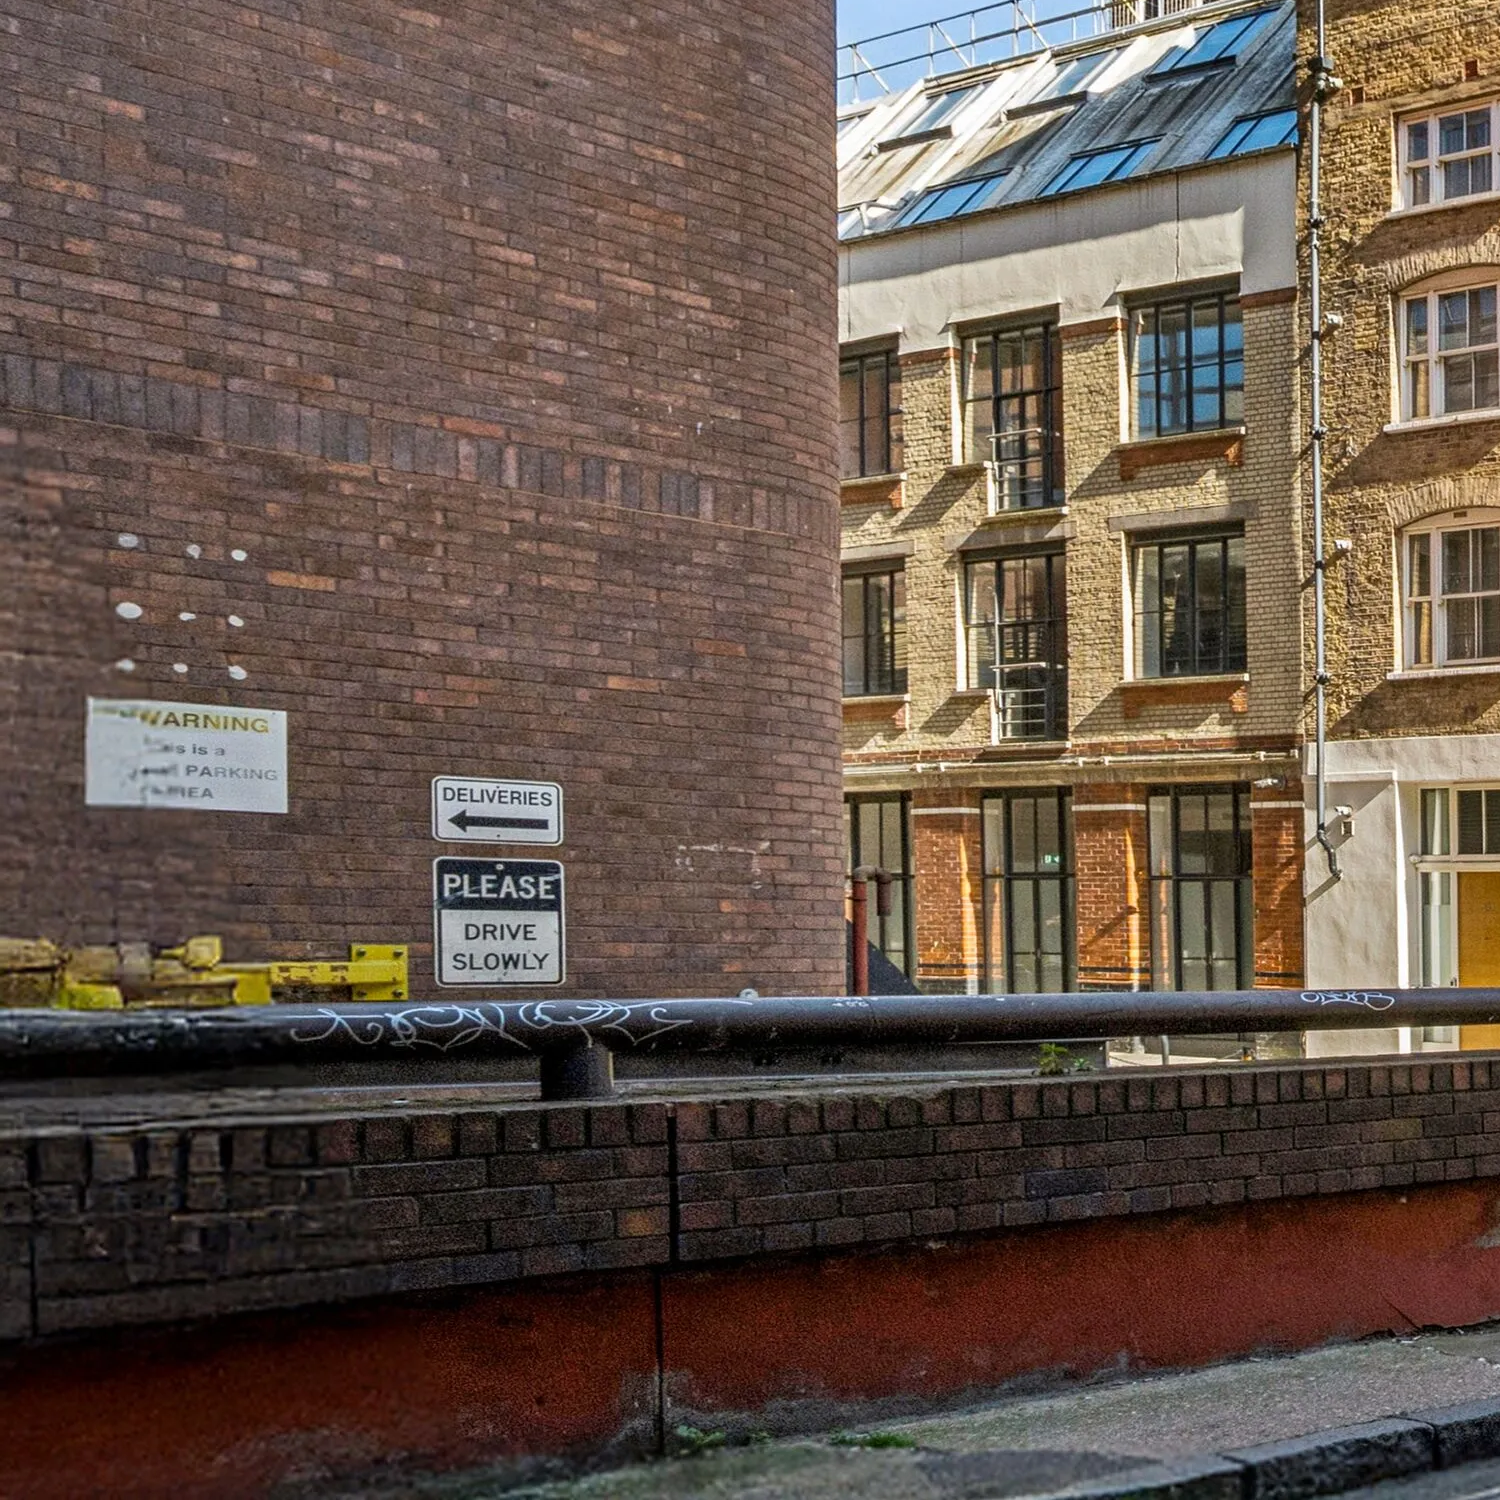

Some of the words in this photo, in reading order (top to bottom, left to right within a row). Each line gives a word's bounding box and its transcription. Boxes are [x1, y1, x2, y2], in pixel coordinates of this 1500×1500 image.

[192, 743, 208, 756] is
[214, 748, 226, 756] a
[185, 764, 278, 781] PARKING
[442, 787, 553, 807] DELIVERIES
[443, 873, 556, 900] PLEASE
[464, 923, 537, 941] DRIVE
[452, 953, 550, 971] SLOWLY
